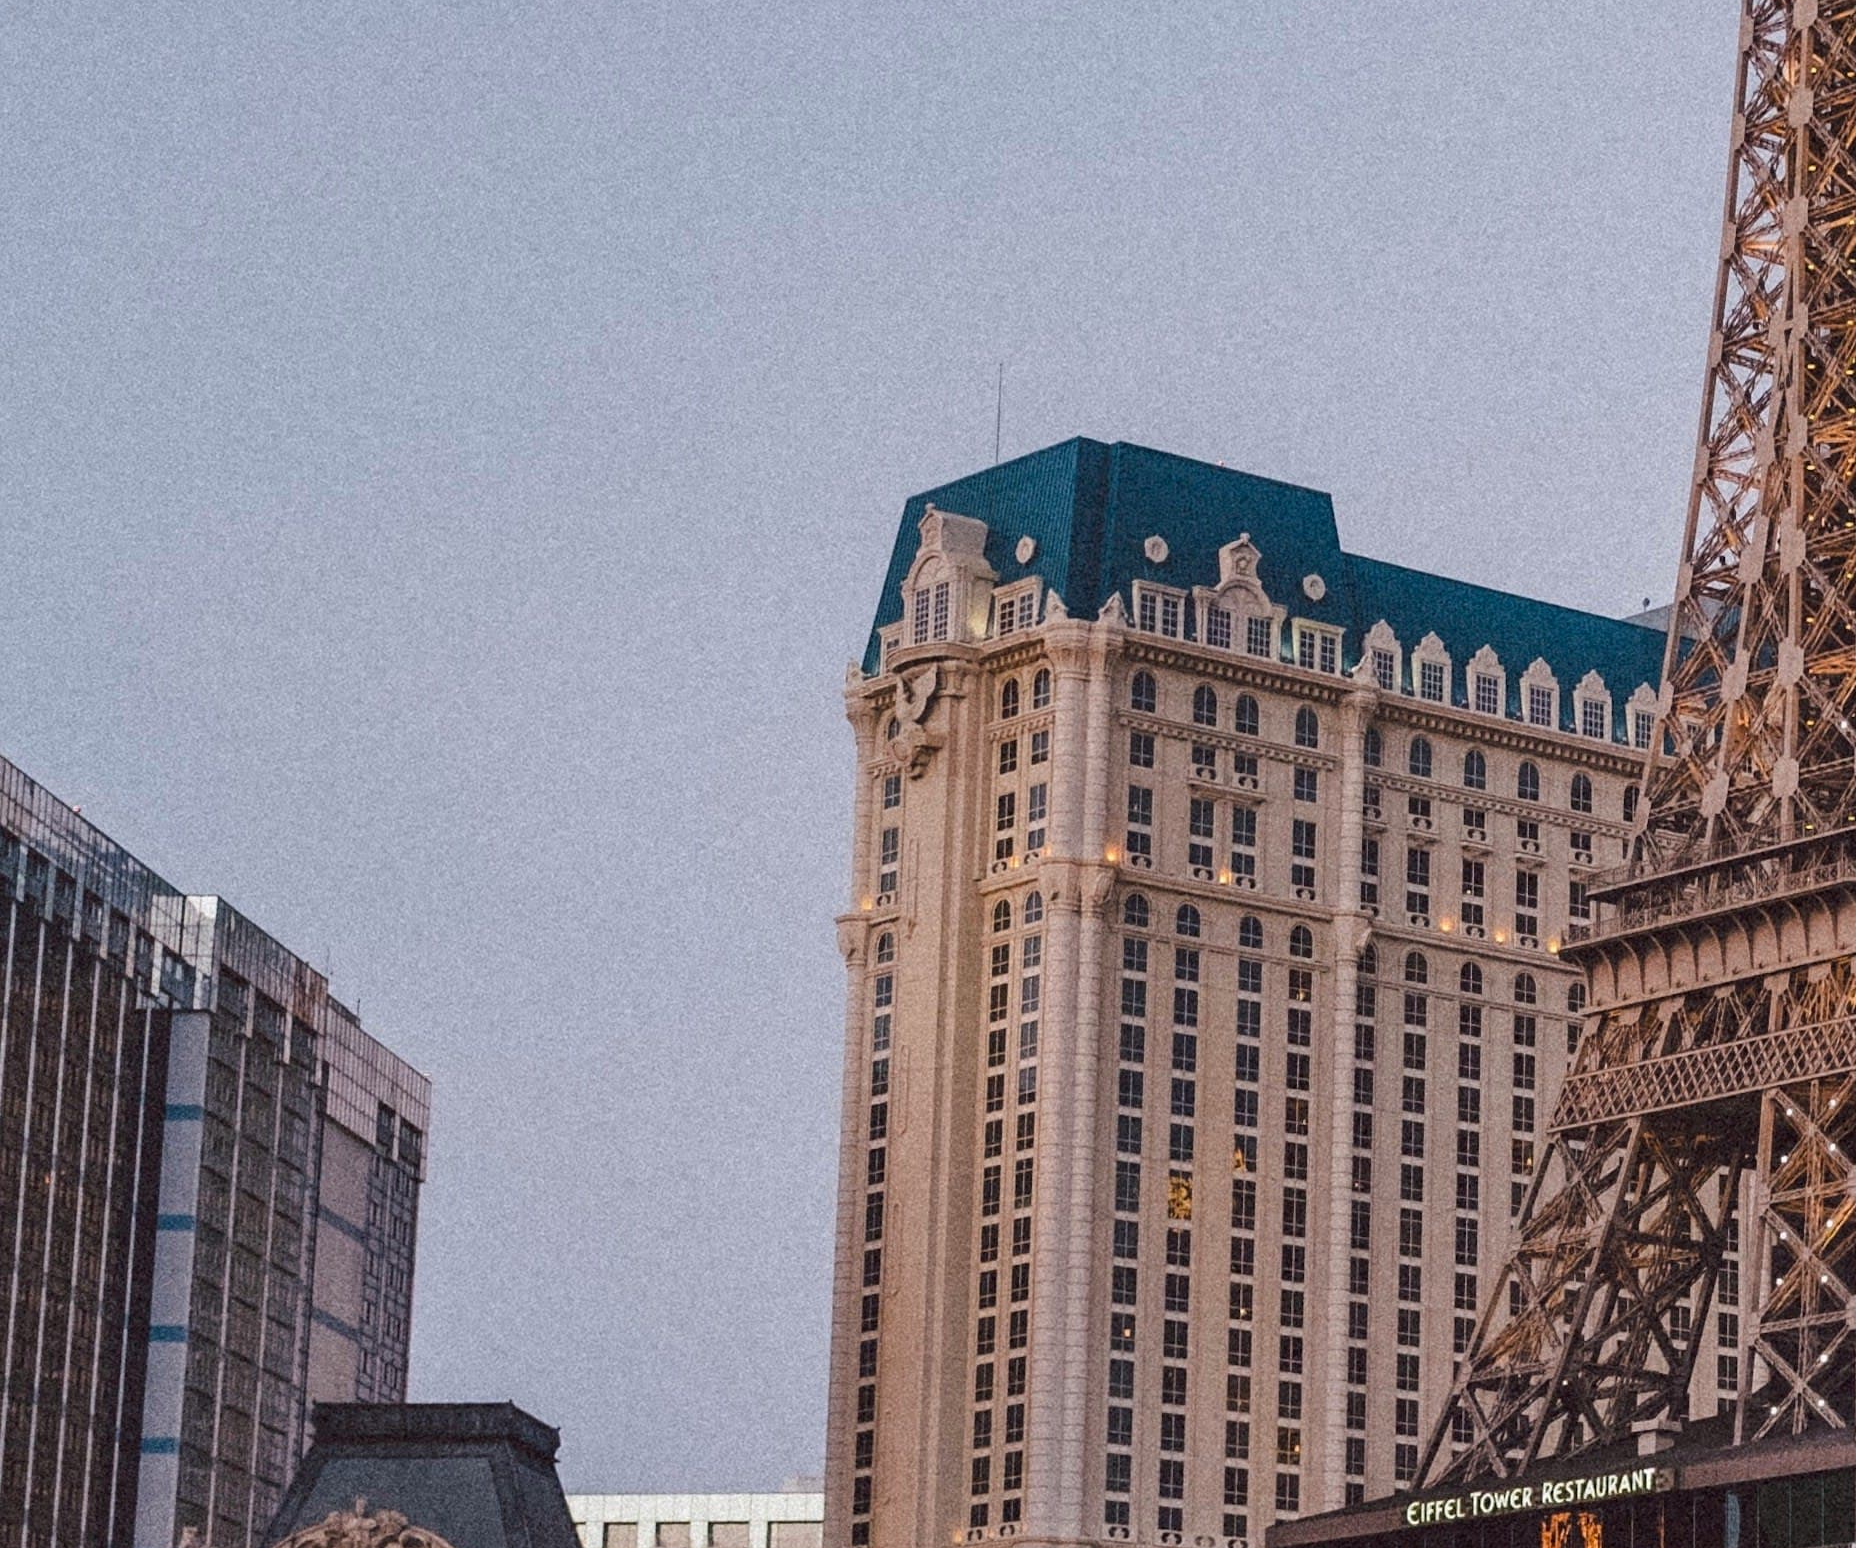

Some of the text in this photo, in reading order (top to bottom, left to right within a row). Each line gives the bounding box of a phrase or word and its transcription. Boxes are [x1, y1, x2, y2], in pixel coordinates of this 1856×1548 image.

[1406, 1468, 1655, 1525] EIFFEL TOWER RESTAURANT
